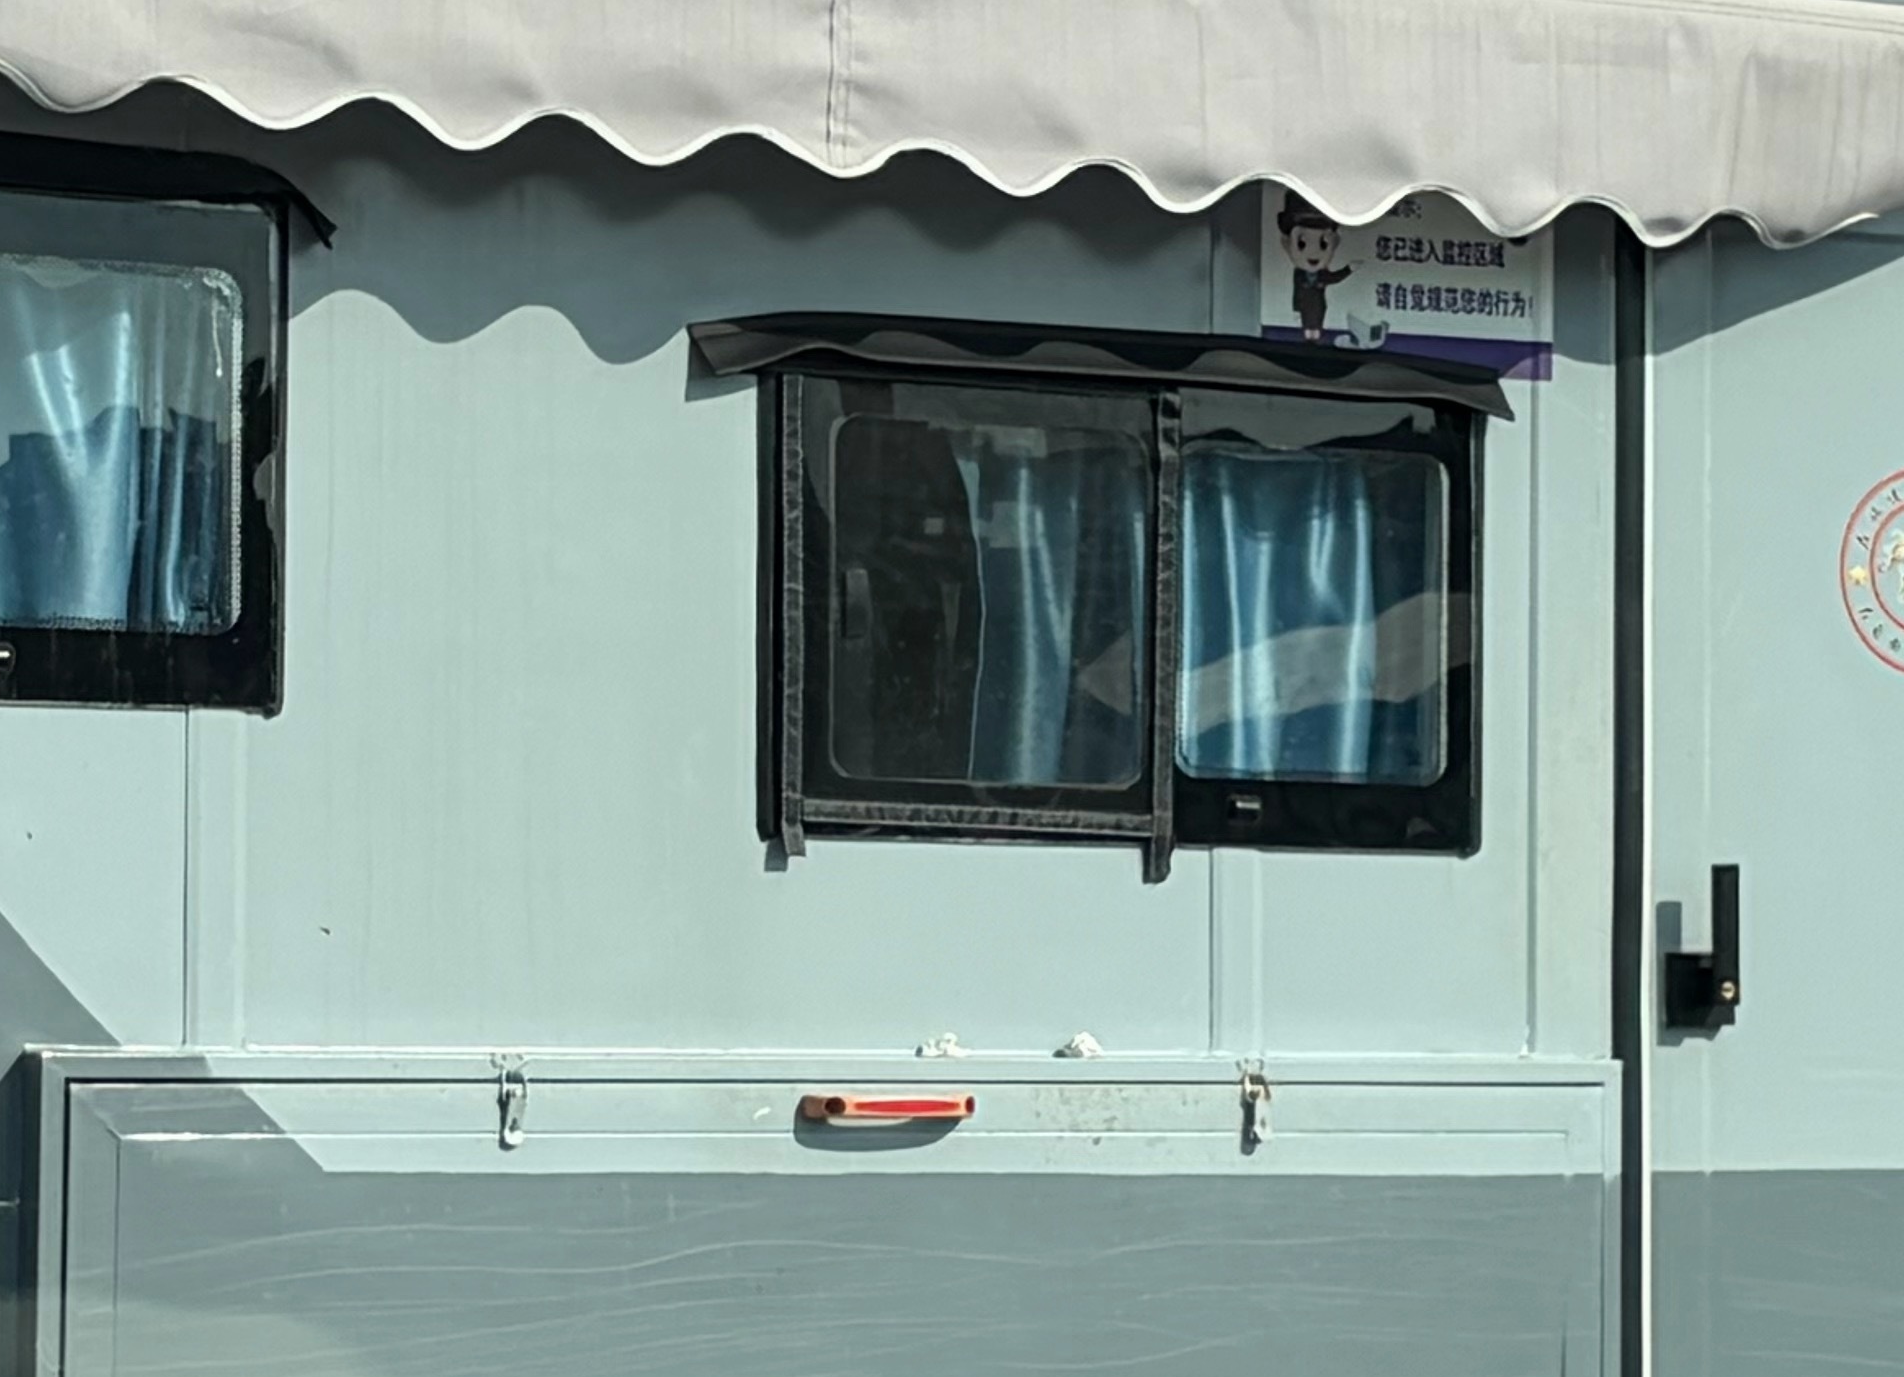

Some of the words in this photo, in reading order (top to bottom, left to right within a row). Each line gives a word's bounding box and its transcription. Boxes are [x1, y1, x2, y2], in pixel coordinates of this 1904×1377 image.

[1375, 235, 1505, 268] 您已进入监控区域
